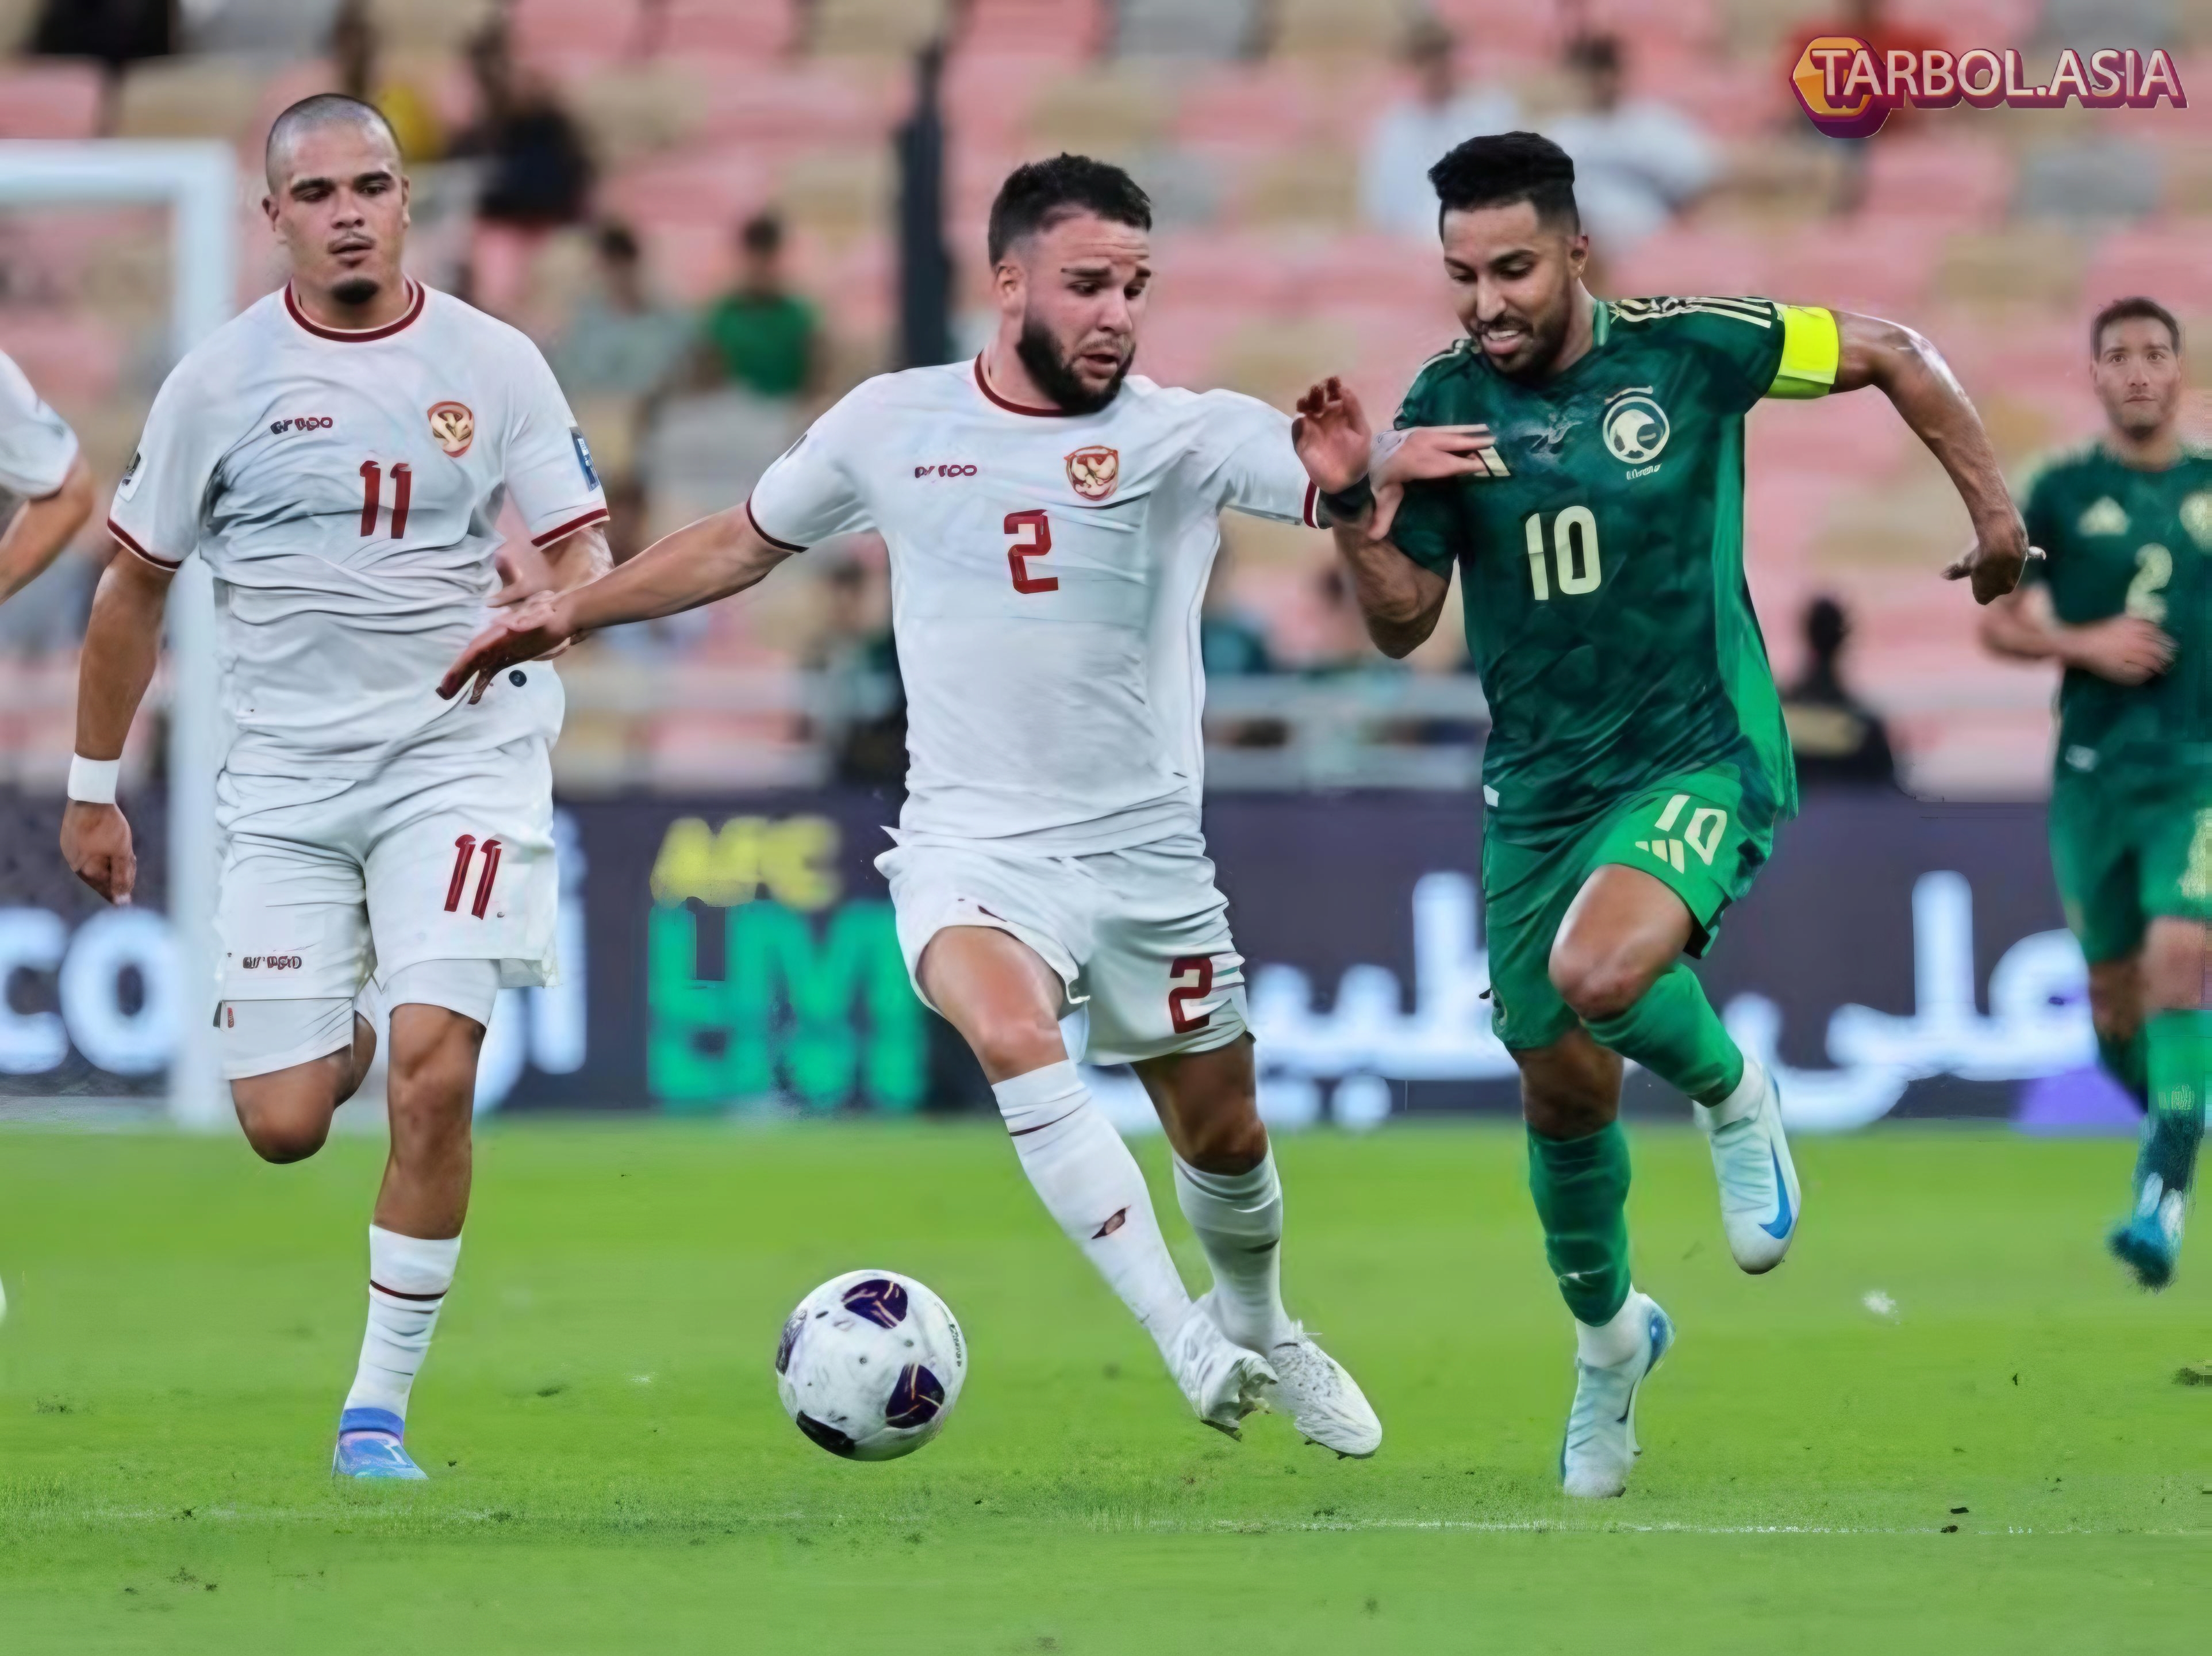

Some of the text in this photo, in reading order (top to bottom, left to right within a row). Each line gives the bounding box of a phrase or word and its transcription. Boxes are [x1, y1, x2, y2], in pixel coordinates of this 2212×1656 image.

[360, 460, 412, 539] 11
[1004, 509, 1059, 594] 2
[1525, 505, 1602, 600] 10
[2126, 542, 2173, 624] 2
[1654, 794, 1727, 866] 10
[444, 834, 502, 920] 11
[1168, 957, 1212, 1034] 2
